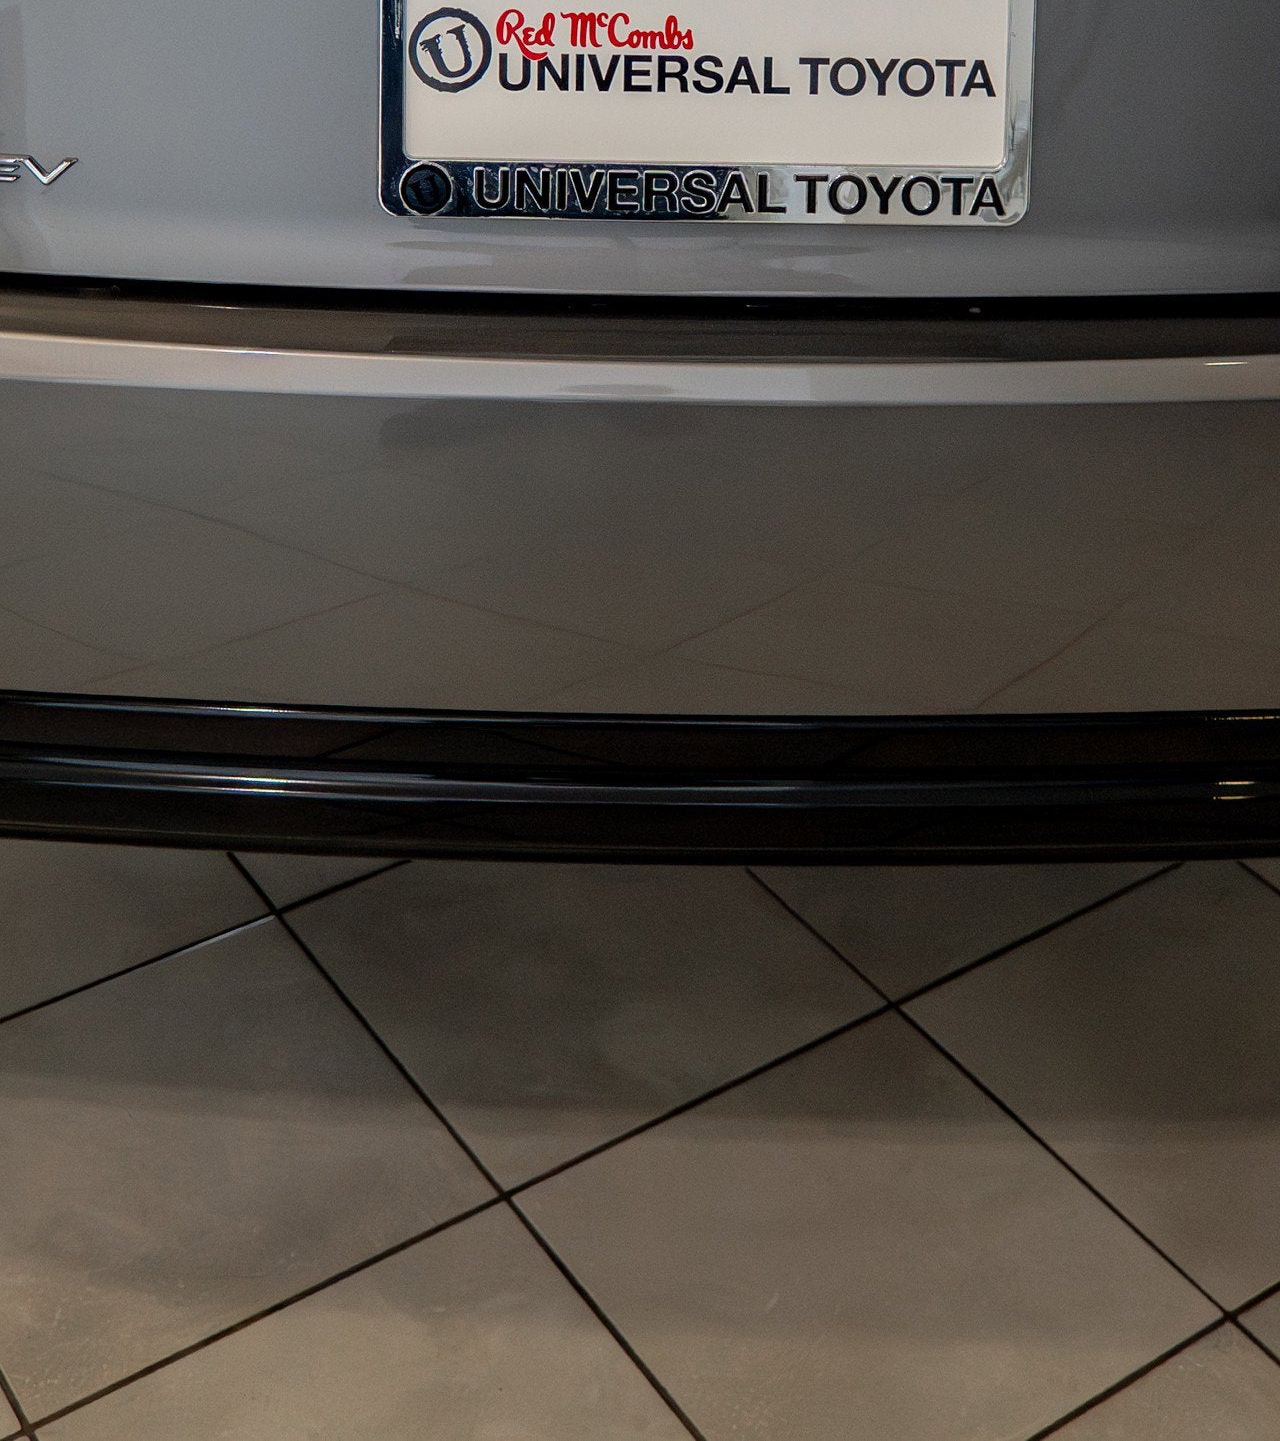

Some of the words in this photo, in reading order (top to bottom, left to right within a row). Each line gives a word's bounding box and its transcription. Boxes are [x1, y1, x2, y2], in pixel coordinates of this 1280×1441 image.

[495, 8, 556, 61] Red
[560, 11, 694, 50] McCombs
[497, 52, 791, 95] UNIVERSAL
[798, 56, 997, 98] TOYOTA
[473, 166, 788, 214] UNIVERSAL
[794, 173, 1007, 217] TOYOTA
